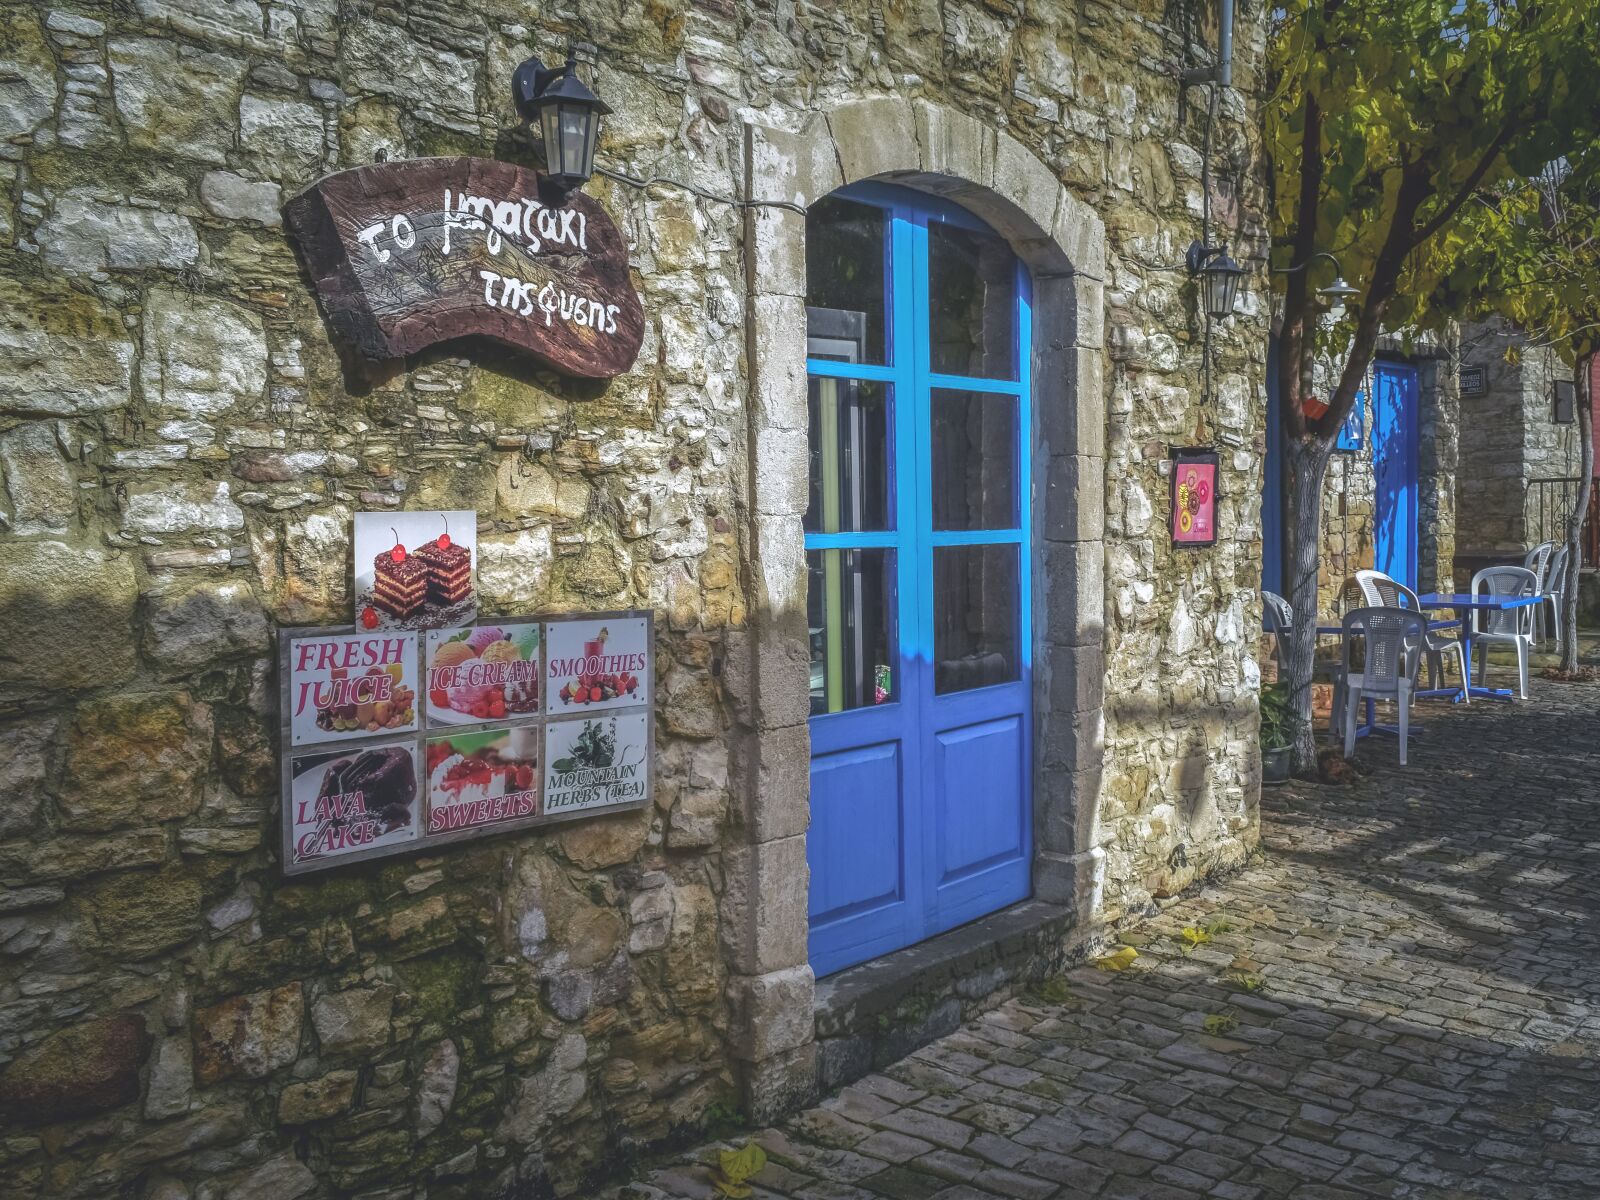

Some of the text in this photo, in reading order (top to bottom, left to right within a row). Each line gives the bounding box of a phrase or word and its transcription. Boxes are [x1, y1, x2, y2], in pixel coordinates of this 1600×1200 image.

[295, 638, 407, 672] FRESH
[549, 652, 646, 678] SMOOTHIES
[428, 659, 537, 691] ICE CREAM
[294, 674, 392, 718] JUICE
[548, 763, 637, 790] MOUNTAIN
[295, 791, 367, 826] LAVA
[428, 791, 535, 831] SWEETS
[547, 781, 645, 810] HERBS (TEA)
[296, 820, 375, 858] CAKE
